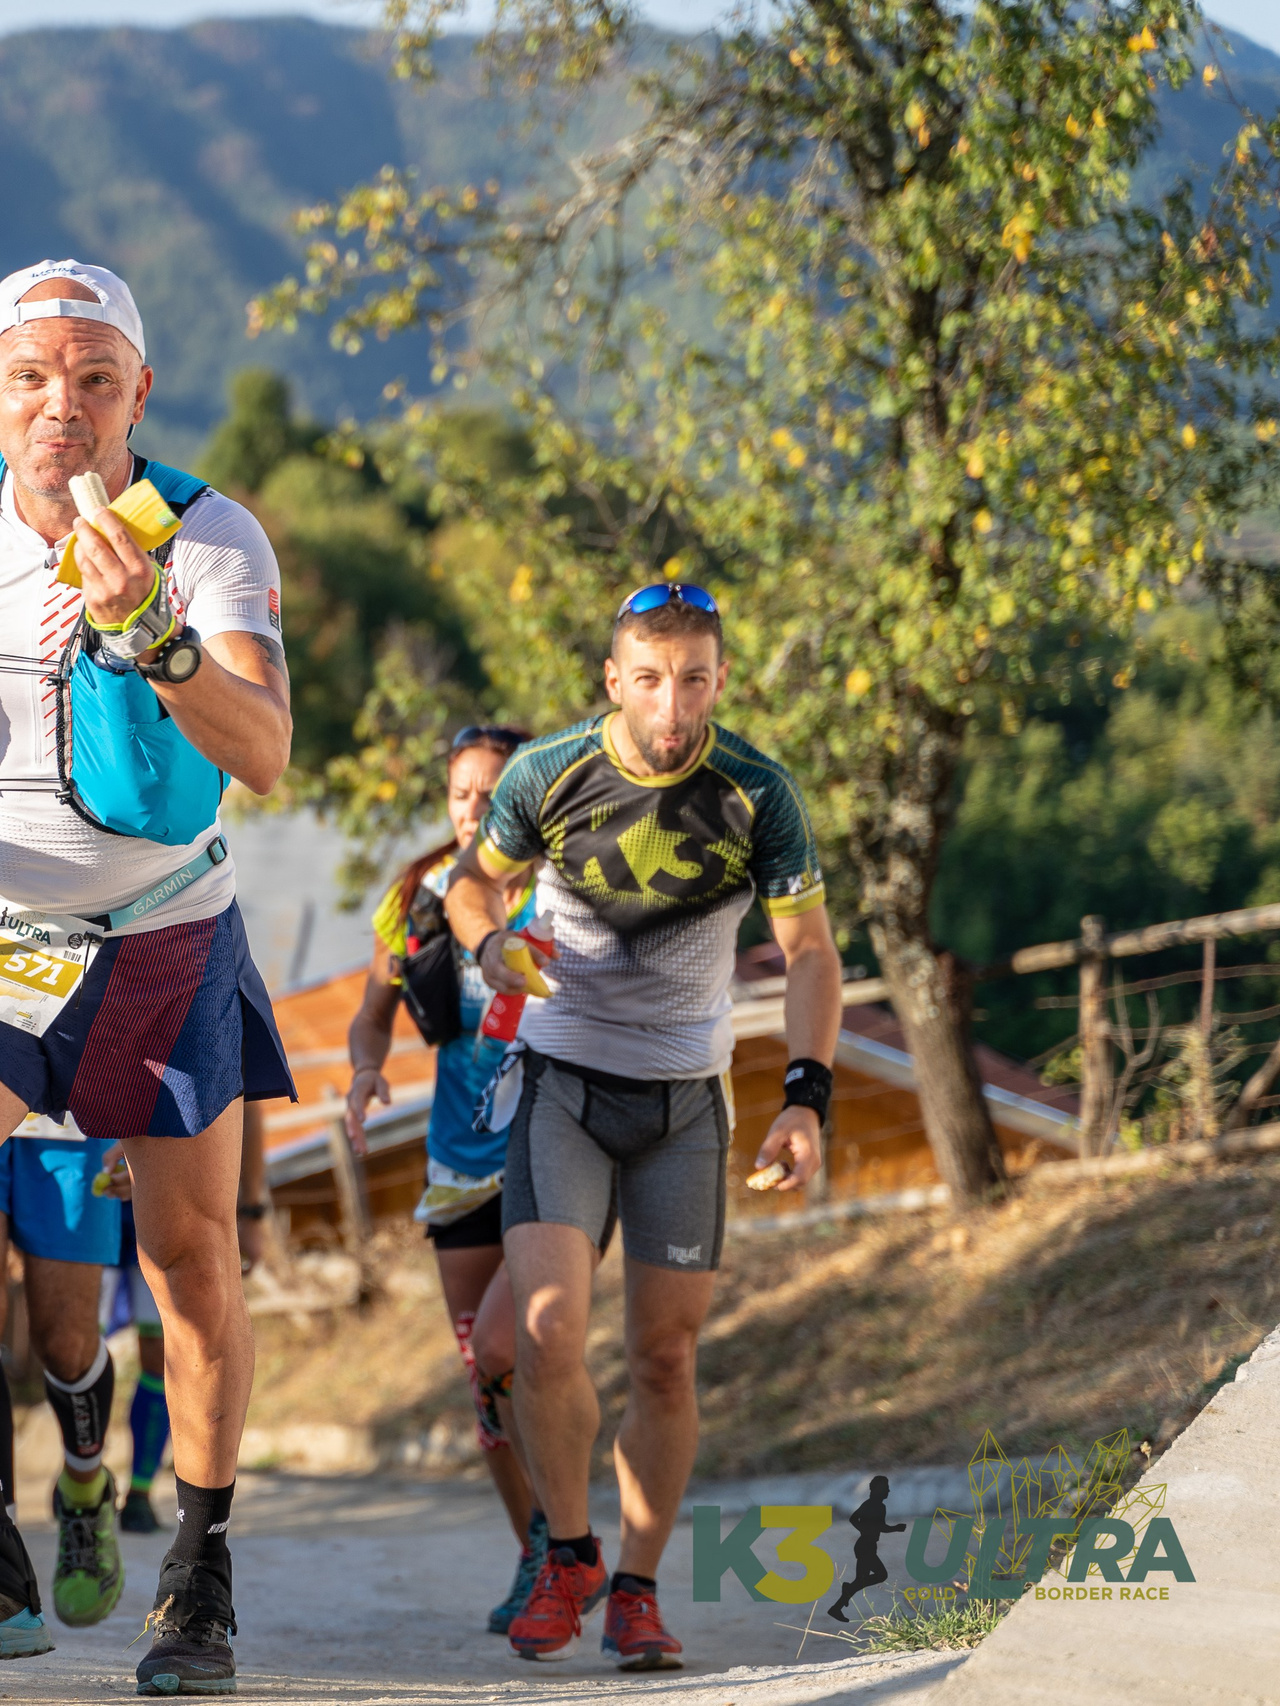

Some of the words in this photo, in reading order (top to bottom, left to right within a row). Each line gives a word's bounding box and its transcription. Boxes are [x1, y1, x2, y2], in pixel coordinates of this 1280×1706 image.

[133, 868, 194, 915] GARMIN
[8, 920, 52, 945] ULTRA
[3, 948, 65, 986] 571
